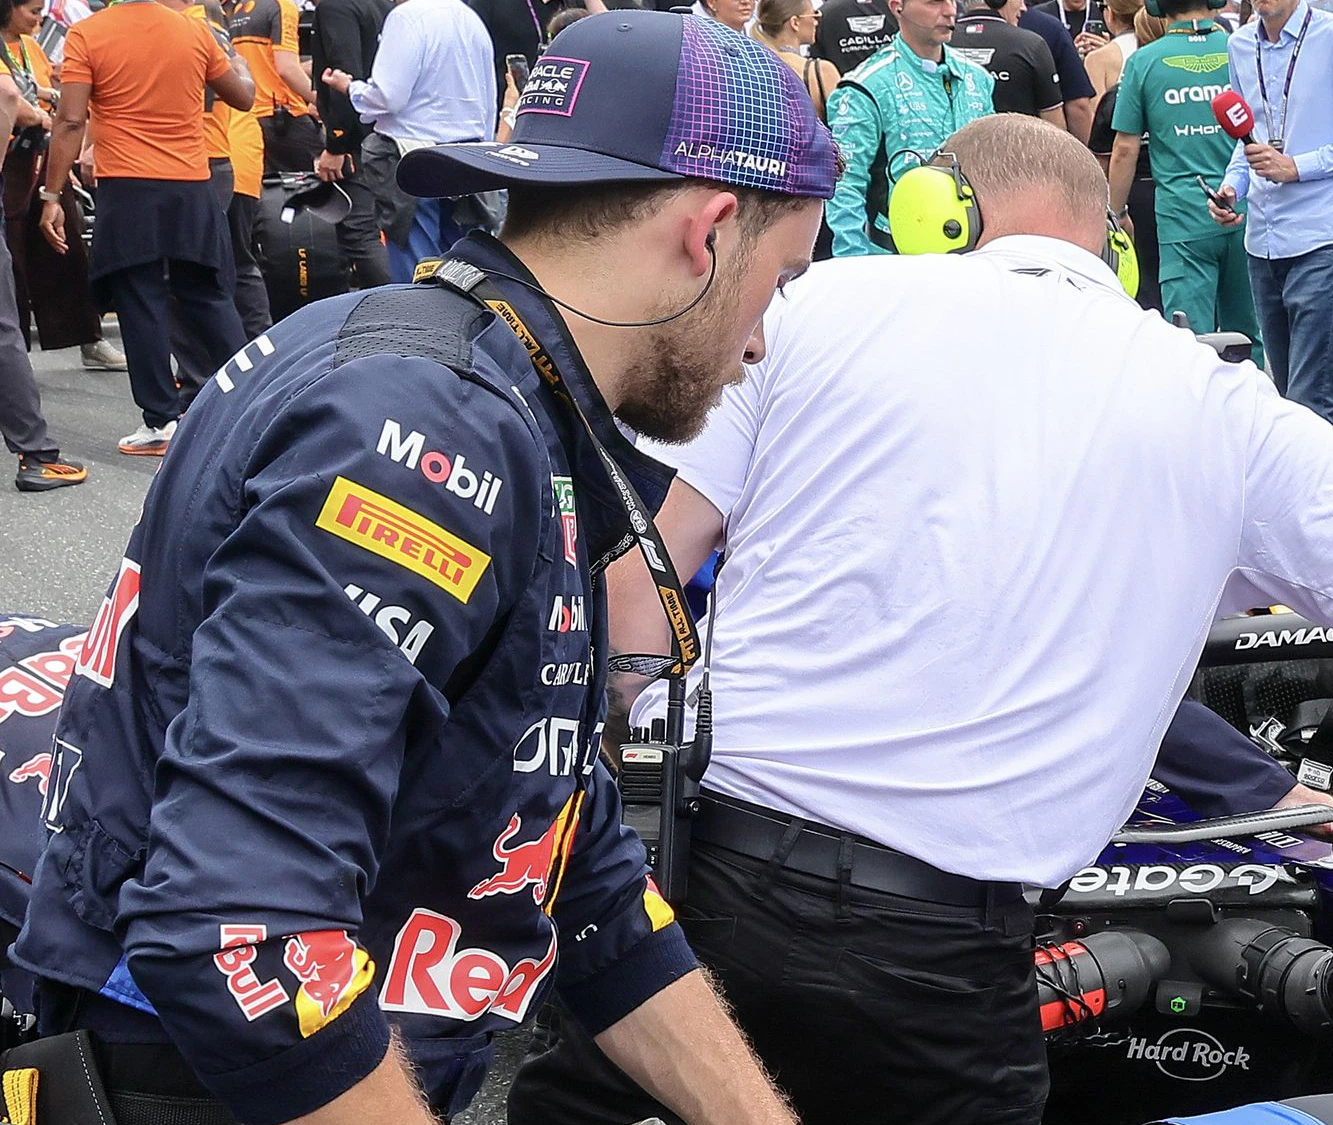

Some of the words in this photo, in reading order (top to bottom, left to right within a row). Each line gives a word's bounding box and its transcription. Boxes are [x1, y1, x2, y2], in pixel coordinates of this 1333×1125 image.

[528, 65, 575, 79] RACLE
[521, 97, 564, 106] ACING
[1165, 84, 1233, 105] aram
[674, 141, 787, 177] ALPHATAURI
[376, 418, 503, 516] Mobil
[334, 494, 473, 586] PIRELLI
[379, 908, 557, 1023] Red
[1127, 1036, 1187, 1064] Hard
[1191, 1041, 1251, 1071] Rock
